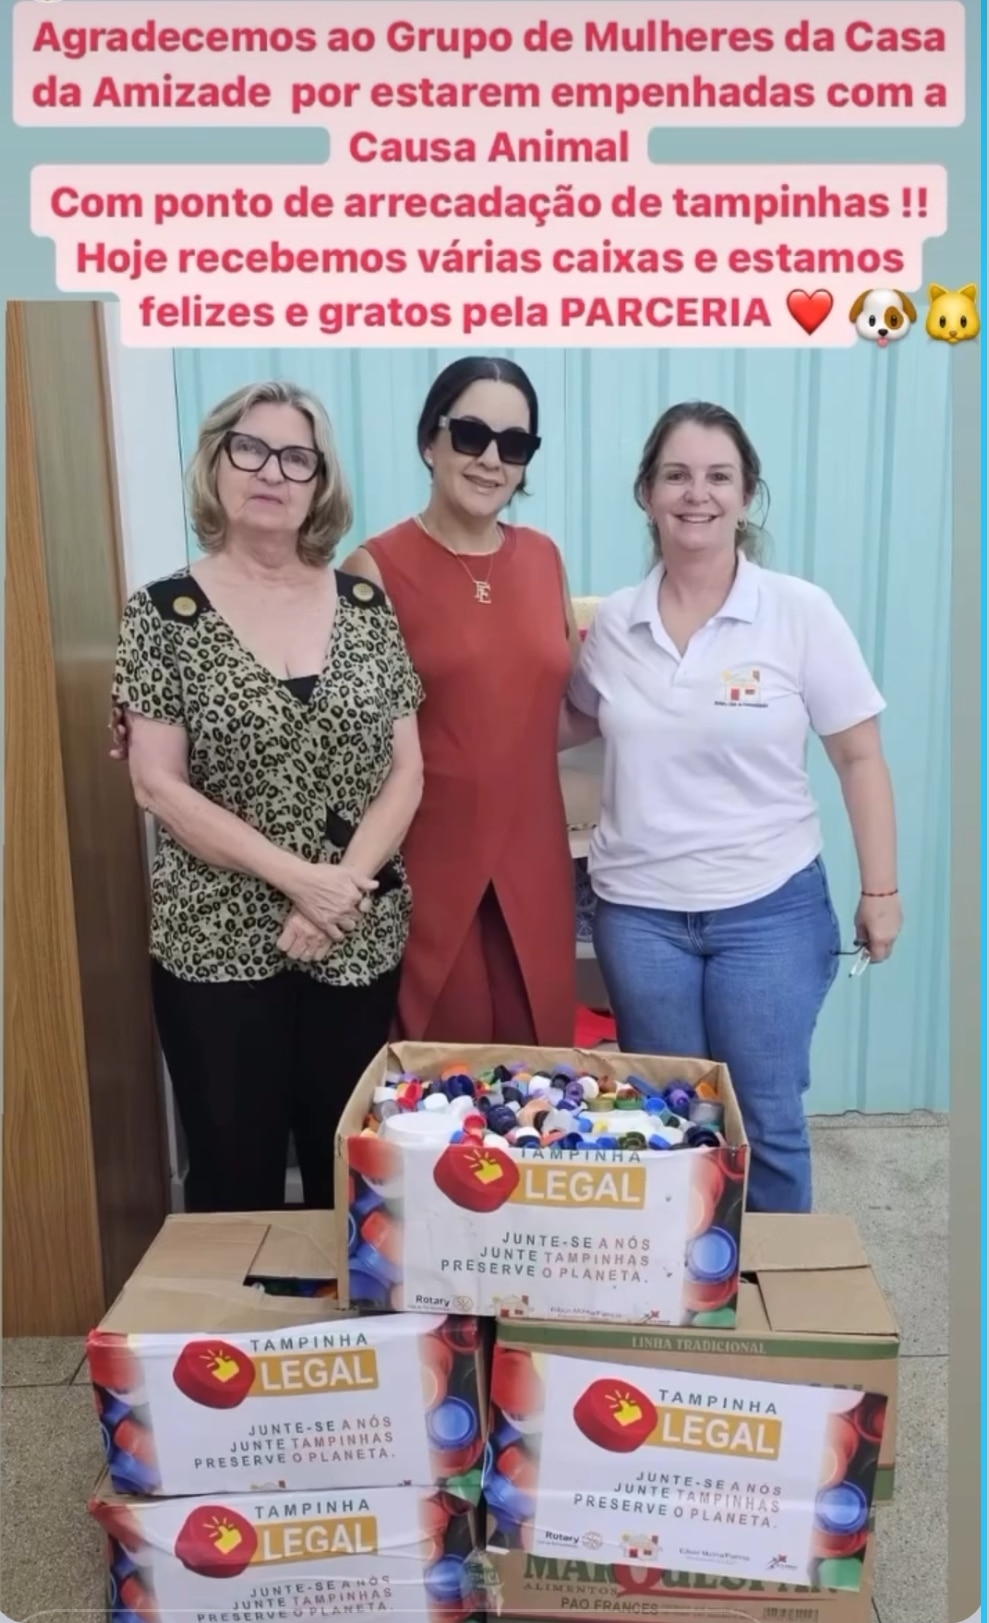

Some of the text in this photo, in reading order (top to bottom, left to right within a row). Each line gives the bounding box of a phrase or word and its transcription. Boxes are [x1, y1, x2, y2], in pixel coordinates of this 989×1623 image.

[521, 1149, 642, 1163] TAMPINHA
[525, 1169, 642, 1203] LEGAL
[502, 1232, 651, 1250] JUNTE-SE A NÓS
[480, 1247, 650, 1267] JUNTE TAMPINHAS
[441, 1259, 649, 1283] PRESERVE O PLANETA.
[415, 1294, 451, 1307] Rotary
[250, 1332, 368, 1353] TAMPINHA
[632, 1336, 767, 1356] LINHA TRADICIONAL
[261, 1354, 374, 1391] LEGAL
[659, 1388, 778, 1415] TAMPINHA
[249, 1414, 392, 1437] JUNTE-SE A NÓS
[662, 1412, 775, 1455] LEGAL
[230, 1431, 394, 1453] JUNTE TAMPINHAS
[194, 1447, 396, 1470] PRESERVE O PLANETA.
[636, 1470, 783, 1496] JUNTE-SE A NÓS
[254, 1498, 370, 1519] TAMPINHA
[613, 1482, 781, 1514] JUNTE TAMPINHAS
[573, 1492, 778, 1529] PRESERVE O PLANETA.
[262, 1522, 374, 1561] LEGAL
[545, 1530, 580, 1545] Rotary
[250, 1574, 391, 1598] JUNTE-SE A NÓS
[523, 1582, 618, 1597] ALIMENTOS
[232, 1587, 392, 1611] JUNTE TAMPINHAS
[197, 1601, 395, 1623] PRESERVE O PLANETA.
